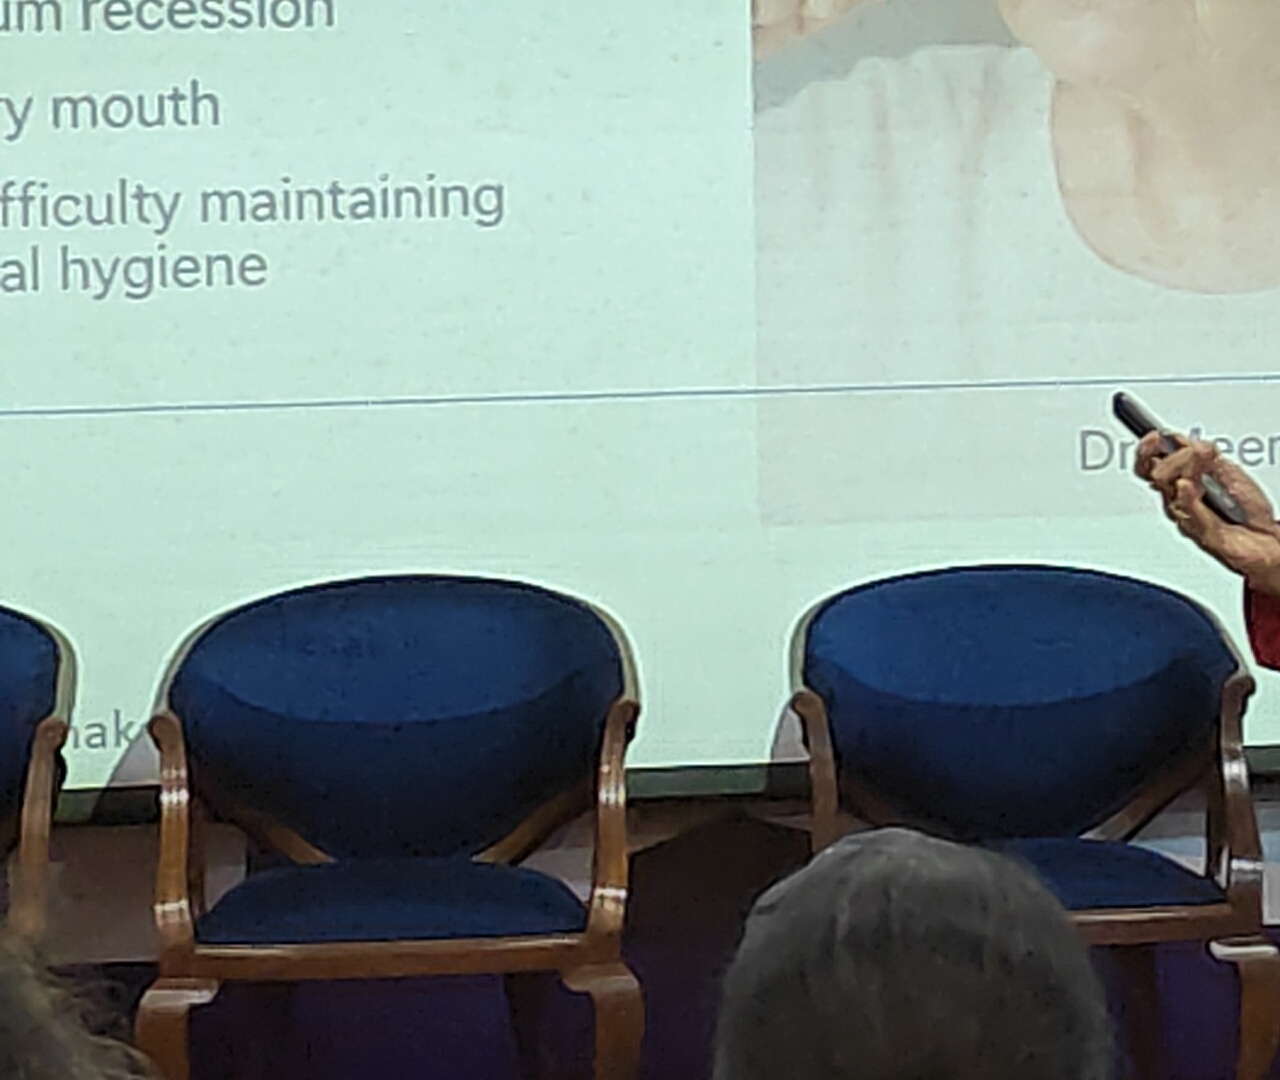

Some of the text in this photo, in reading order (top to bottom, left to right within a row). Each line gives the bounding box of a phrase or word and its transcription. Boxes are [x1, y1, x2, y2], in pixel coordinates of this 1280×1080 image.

[51, 78, 222, 129] mouth
[200, 173, 506, 228] maintaining
[1, 243, 269, 300] al hygiene
